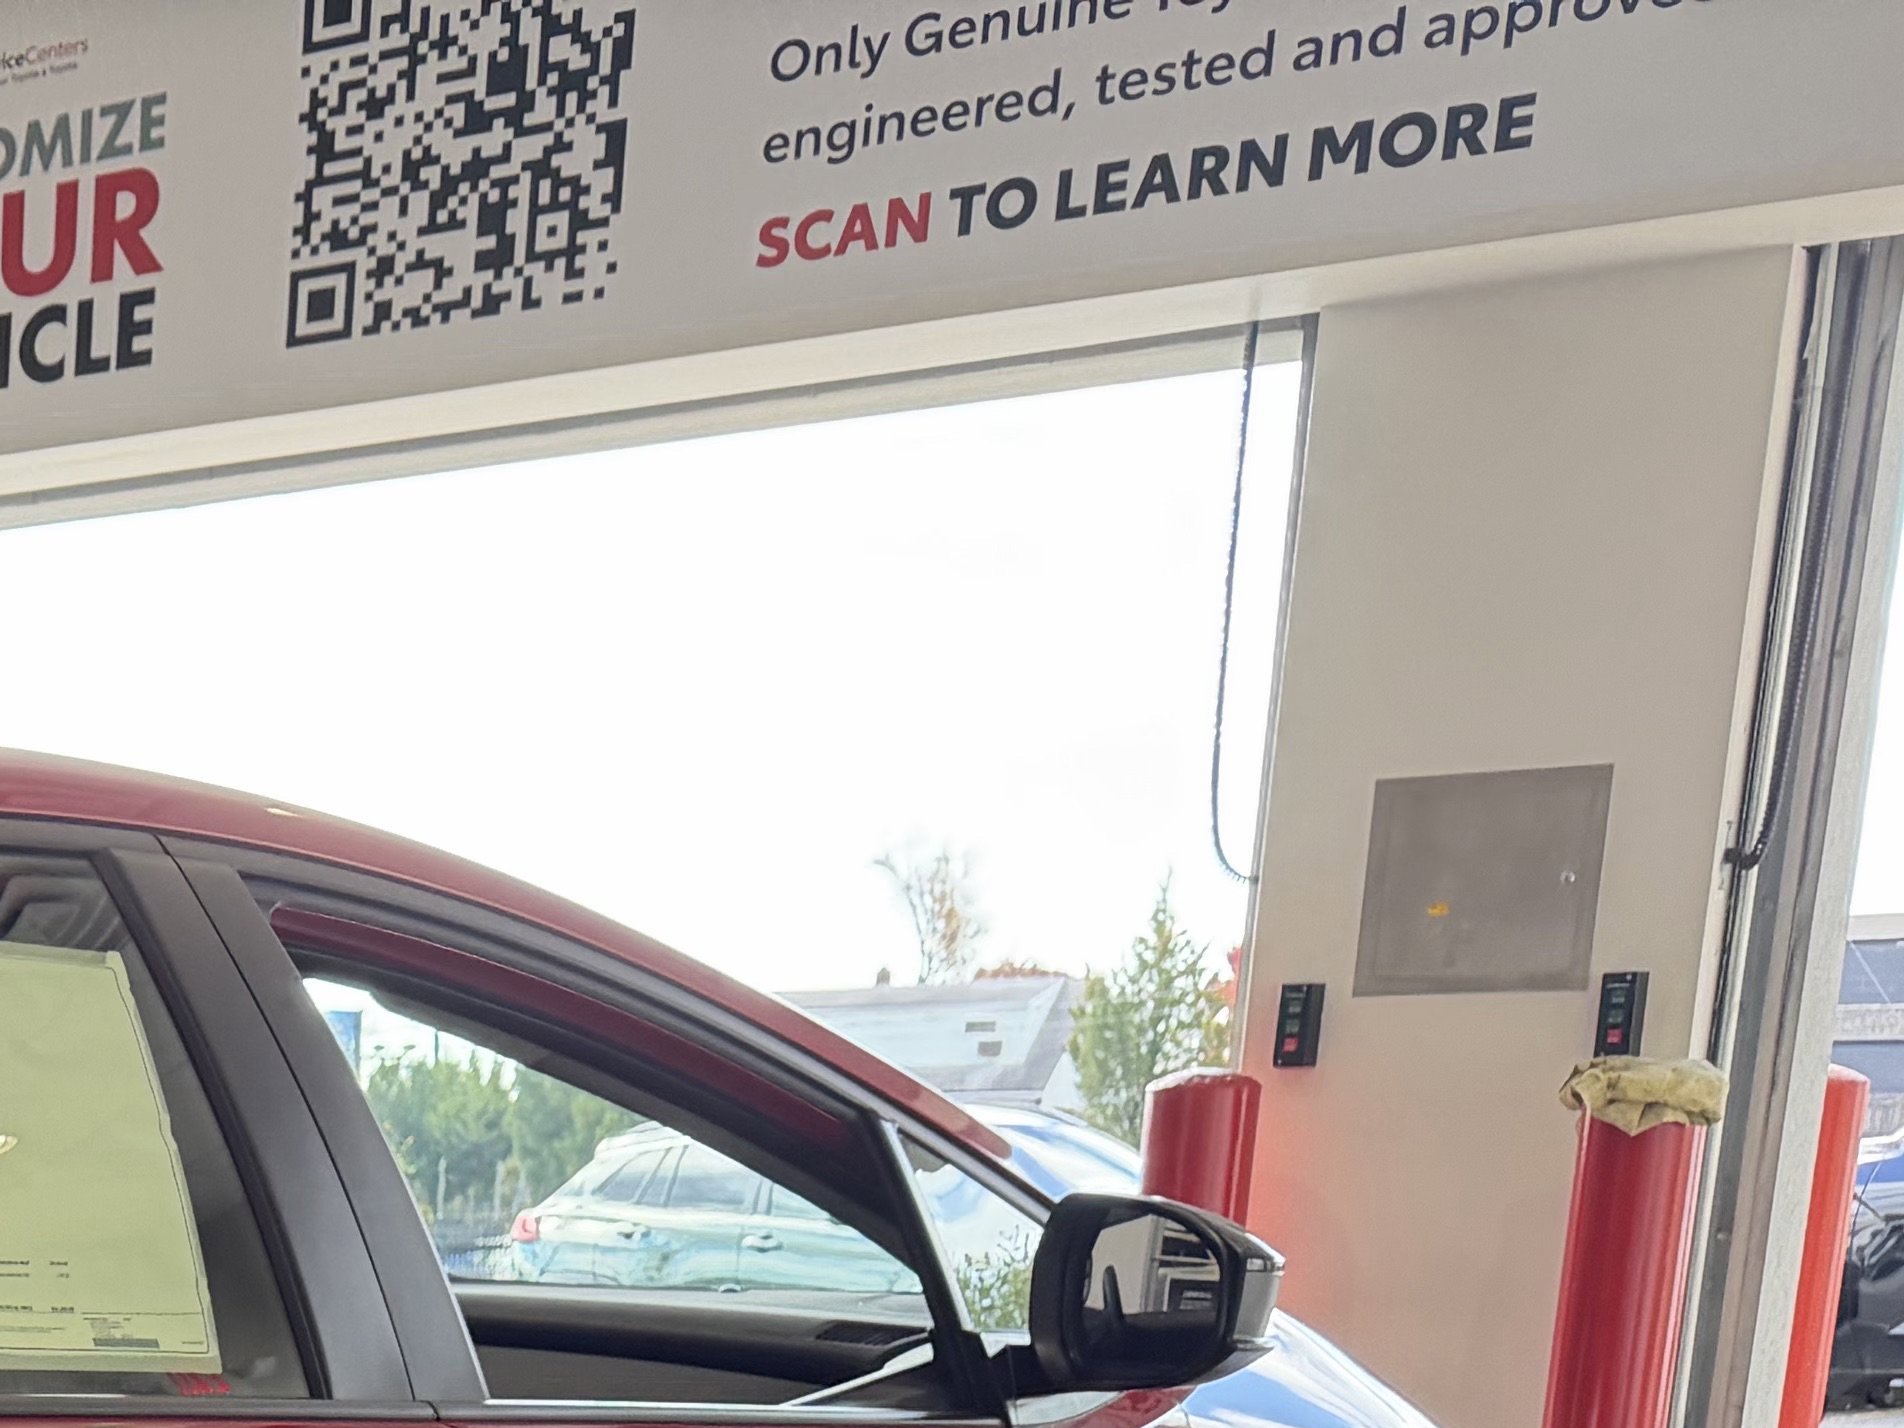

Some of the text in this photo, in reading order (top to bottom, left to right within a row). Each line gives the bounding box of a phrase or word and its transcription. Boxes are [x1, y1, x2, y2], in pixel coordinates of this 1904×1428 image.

[762, 67, 1077, 165] engineered,
[1095, 28, 1277, 105] tested
[1292, 5, 1407, 72] and
[770, 0, 1132, 83] Only Genuine
[755, 92, 1538, 269] SCAN TO LEARN MORE
